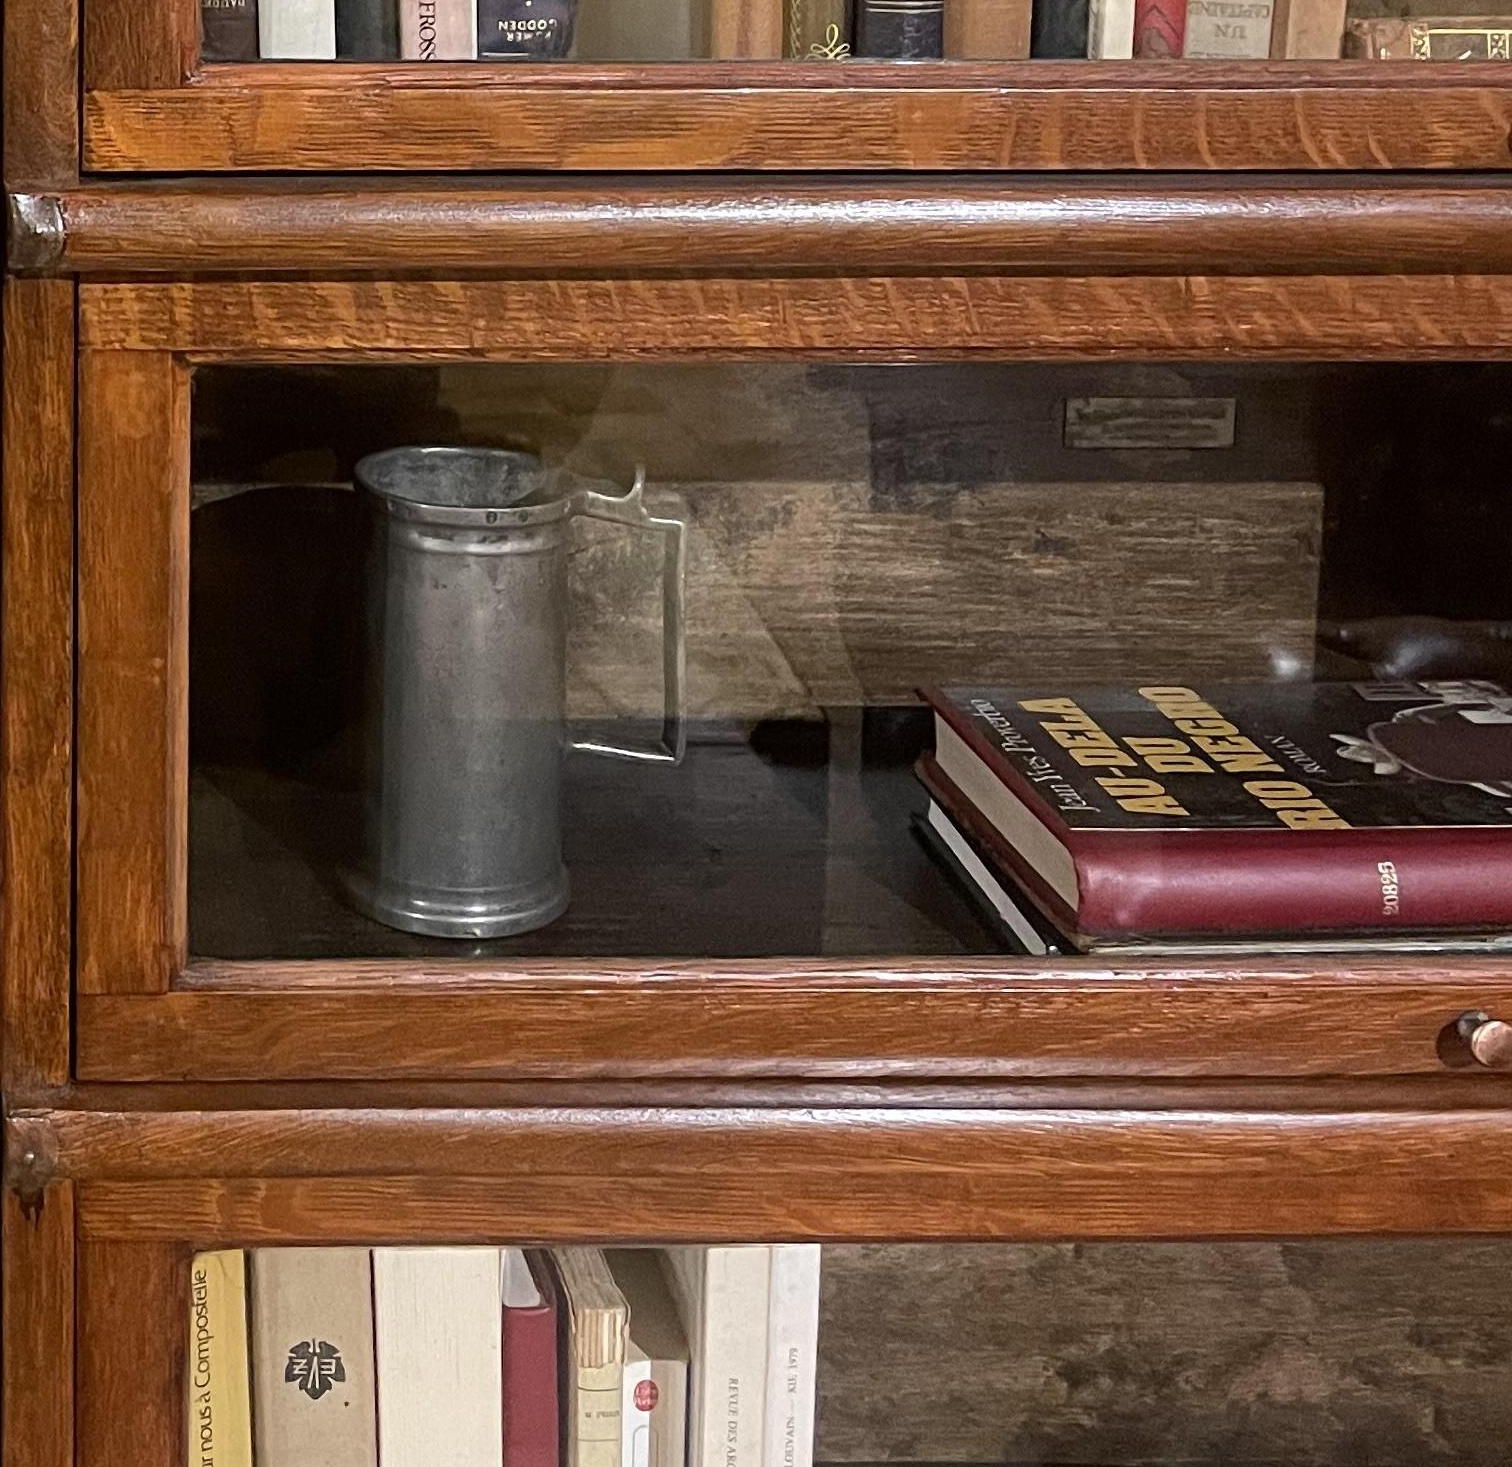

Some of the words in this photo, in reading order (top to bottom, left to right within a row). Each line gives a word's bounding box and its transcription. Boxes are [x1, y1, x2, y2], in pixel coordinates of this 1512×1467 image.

[1138, 686, 1286, 773] NEGRO
[1016, 697, 1192, 817] AU-DELA
[1023, 751, 1063, 784] Yves
[1121, 736, 1215, 773] DU
[1264, 734, 1328, 775] ROMAN
[1049, 781, 1101, 813] Jean
[1242, 780, 1354, 829] RIO
[1377, 861, 1399, 917] 20825
[193, 1269, 215, 1388] Compostelle
[195, 1390, 211, 1403] à
[727, 1378, 739, 1417] REVUE
[200, 1404, 214, 1452] nous
[727, 1420, 738, 1443] DES
